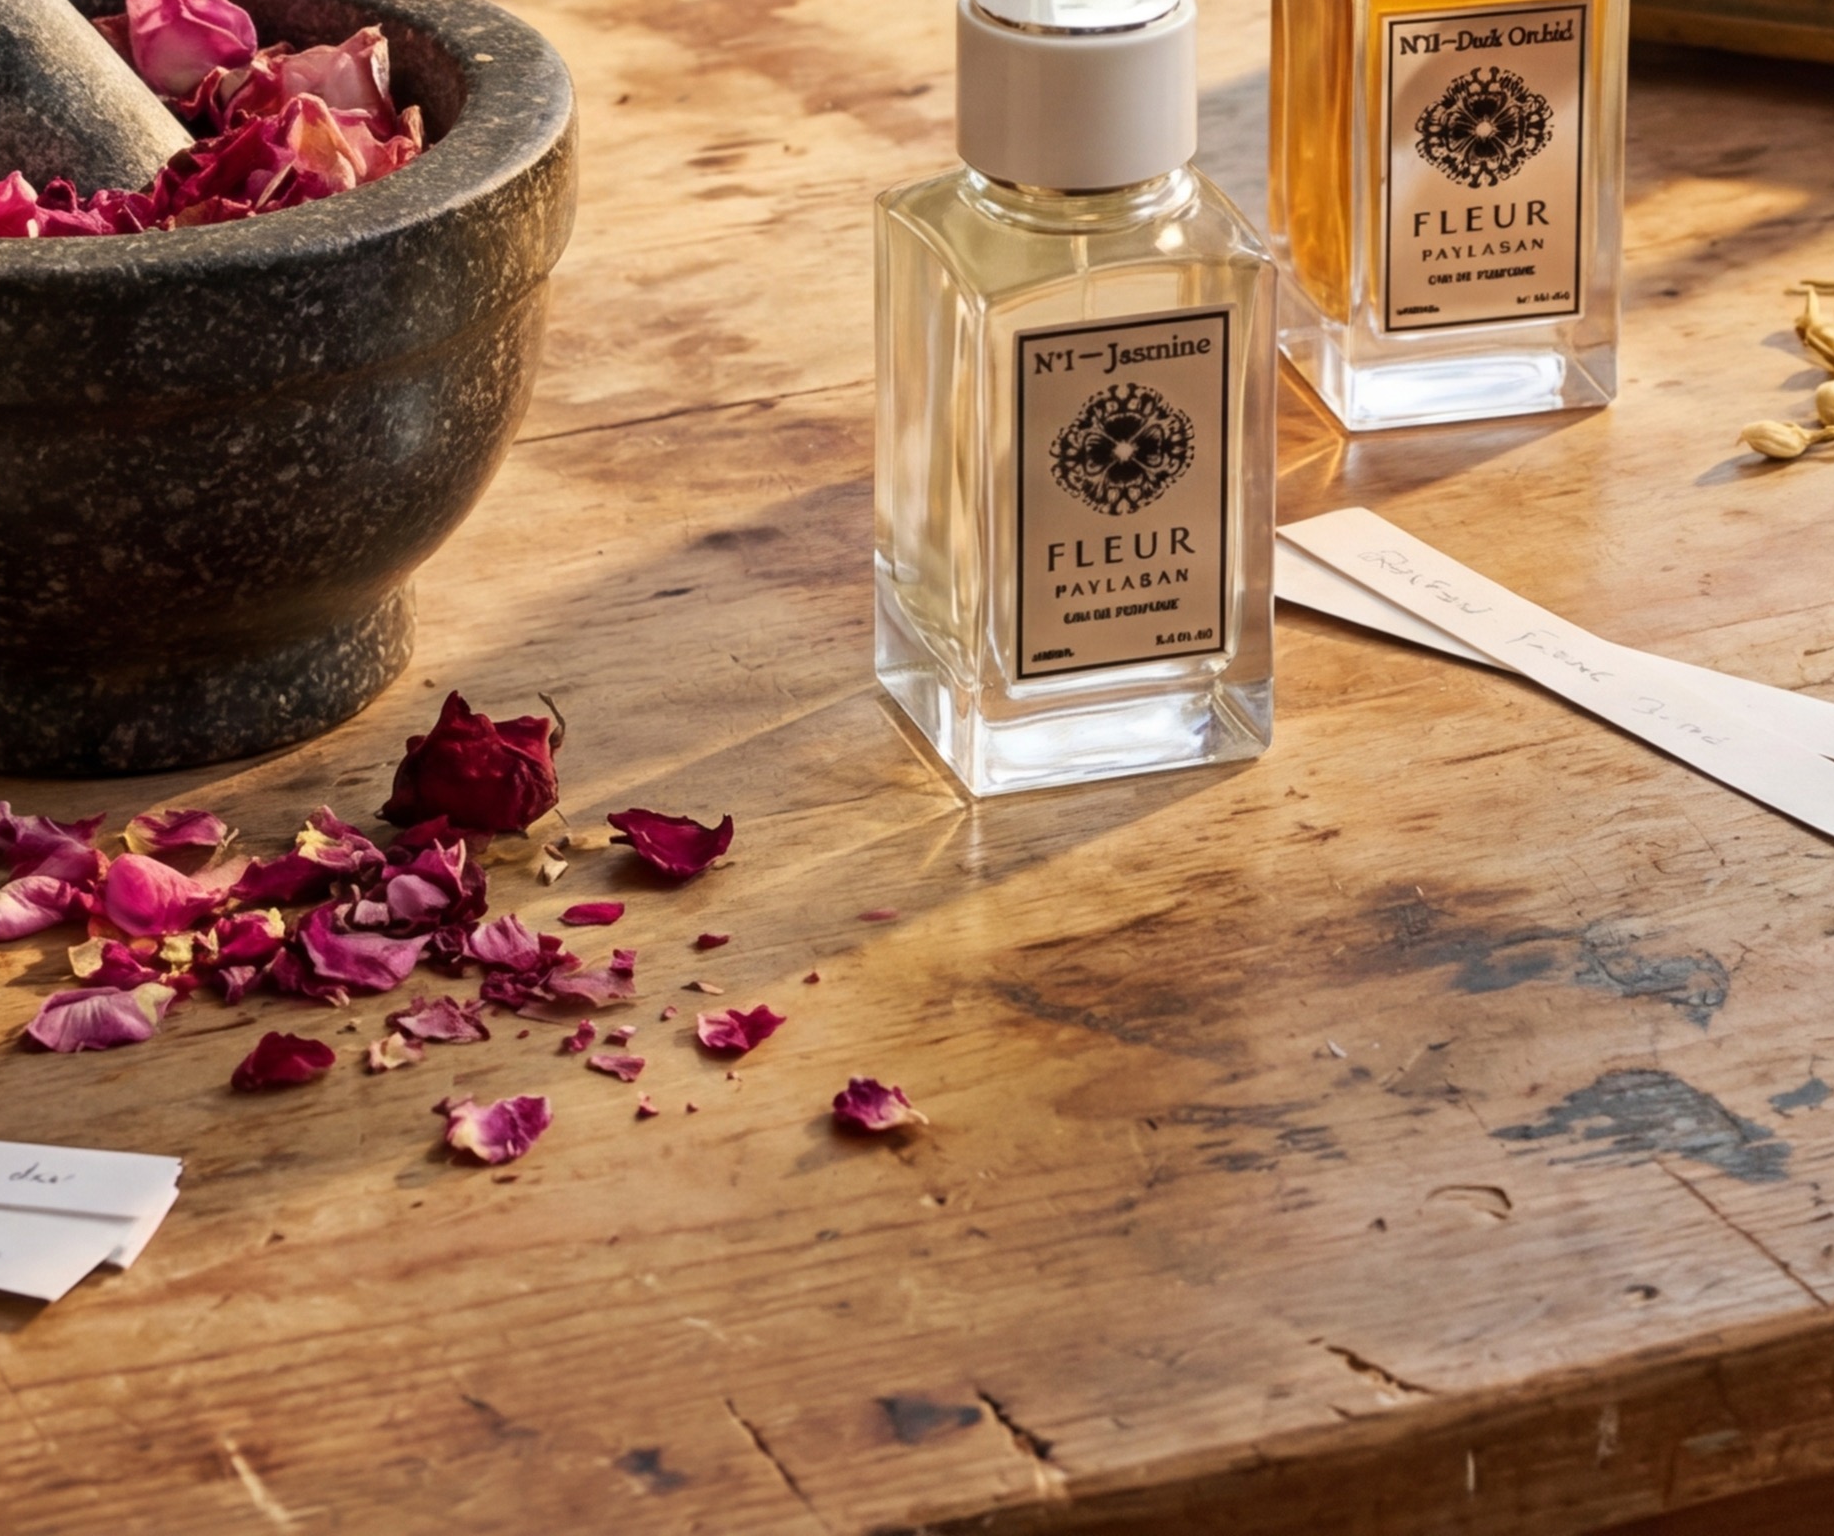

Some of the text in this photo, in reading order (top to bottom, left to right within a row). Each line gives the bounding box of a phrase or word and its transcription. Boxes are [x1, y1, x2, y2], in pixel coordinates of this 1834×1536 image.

[1414, 200, 1549, 237] FLEUR
[1422, 238, 1544, 262] PAYLASAN
[1048, 526, 1196, 572] FLEUR
